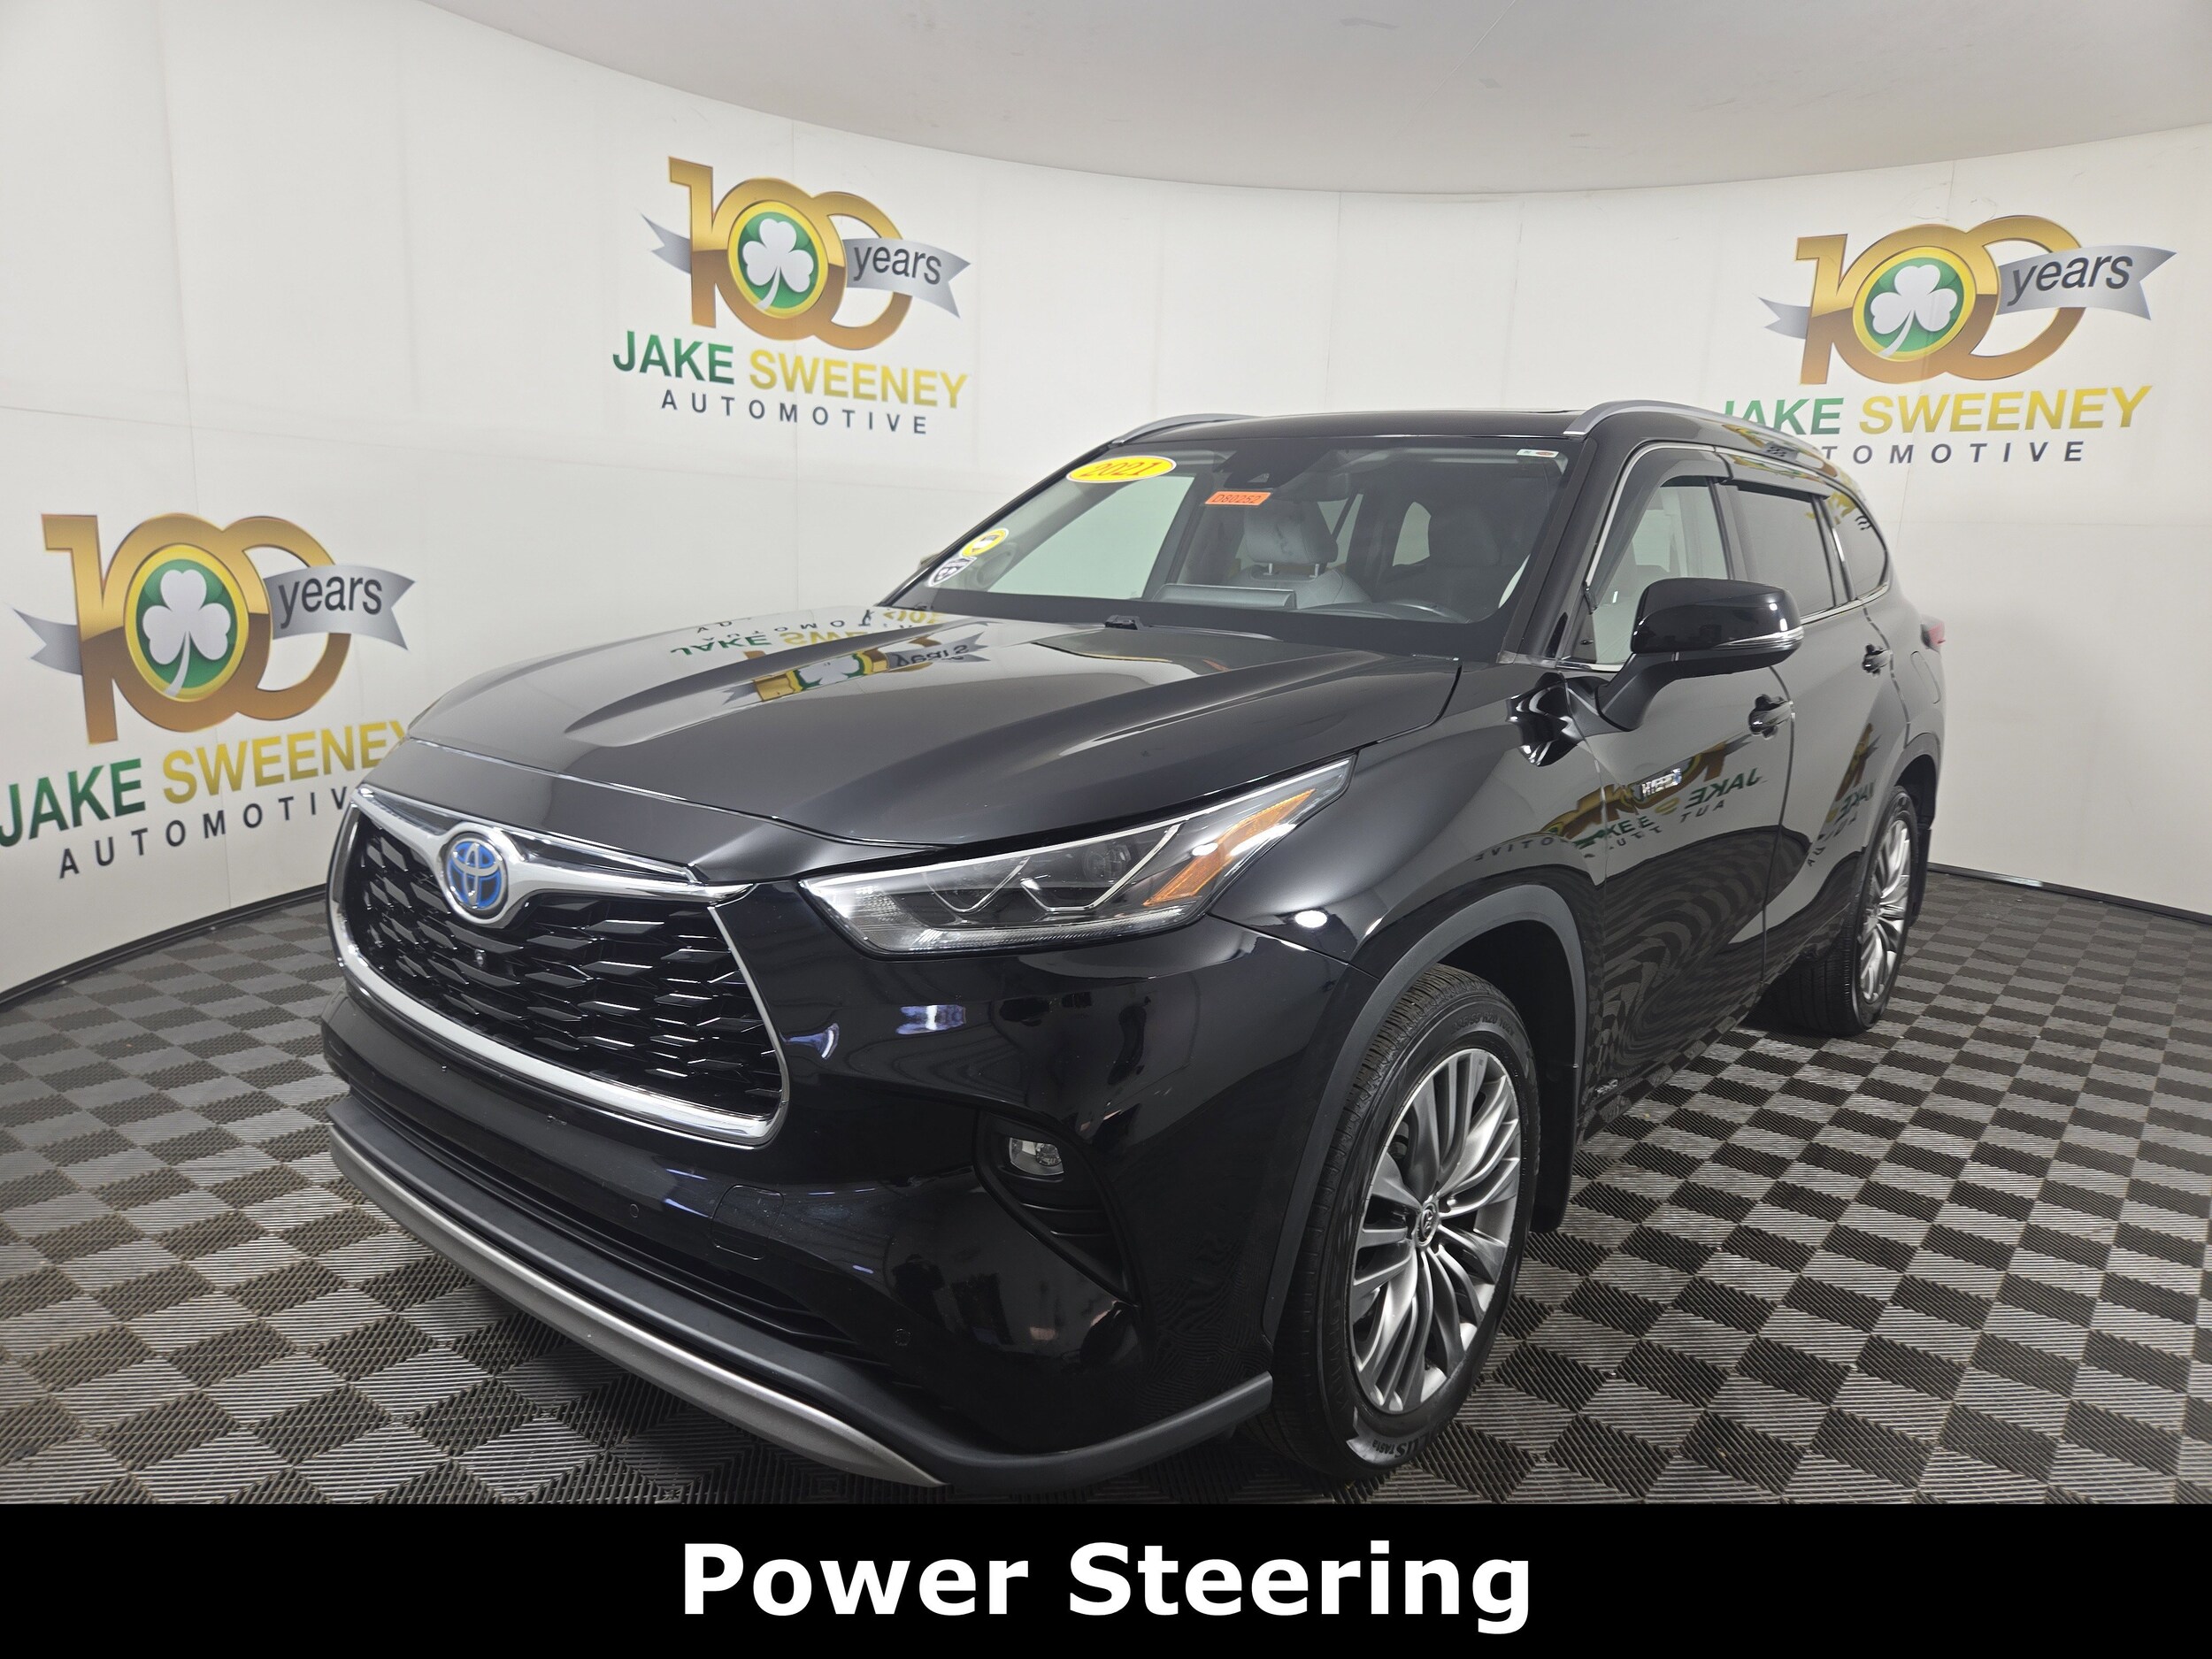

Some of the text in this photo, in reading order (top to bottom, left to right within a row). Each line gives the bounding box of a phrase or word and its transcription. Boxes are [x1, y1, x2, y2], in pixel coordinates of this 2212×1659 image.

[853, 246, 941, 285] years
[2007, 254, 2133, 306] years
[612, 330, 968, 409] JAKE SWEENEY
[661, 389, 927, 434] AUTOMOTIVE
[1859, 385, 2153, 434] SWEENEY
[1080, 461, 1163, 477] 2021
[1821, 441, 2085, 465] TOMOTIVE
[278, 576, 383, 629] years
[0, 758, 146, 847] JAKE
[59, 787, 348, 879] AUTOMOTIV
